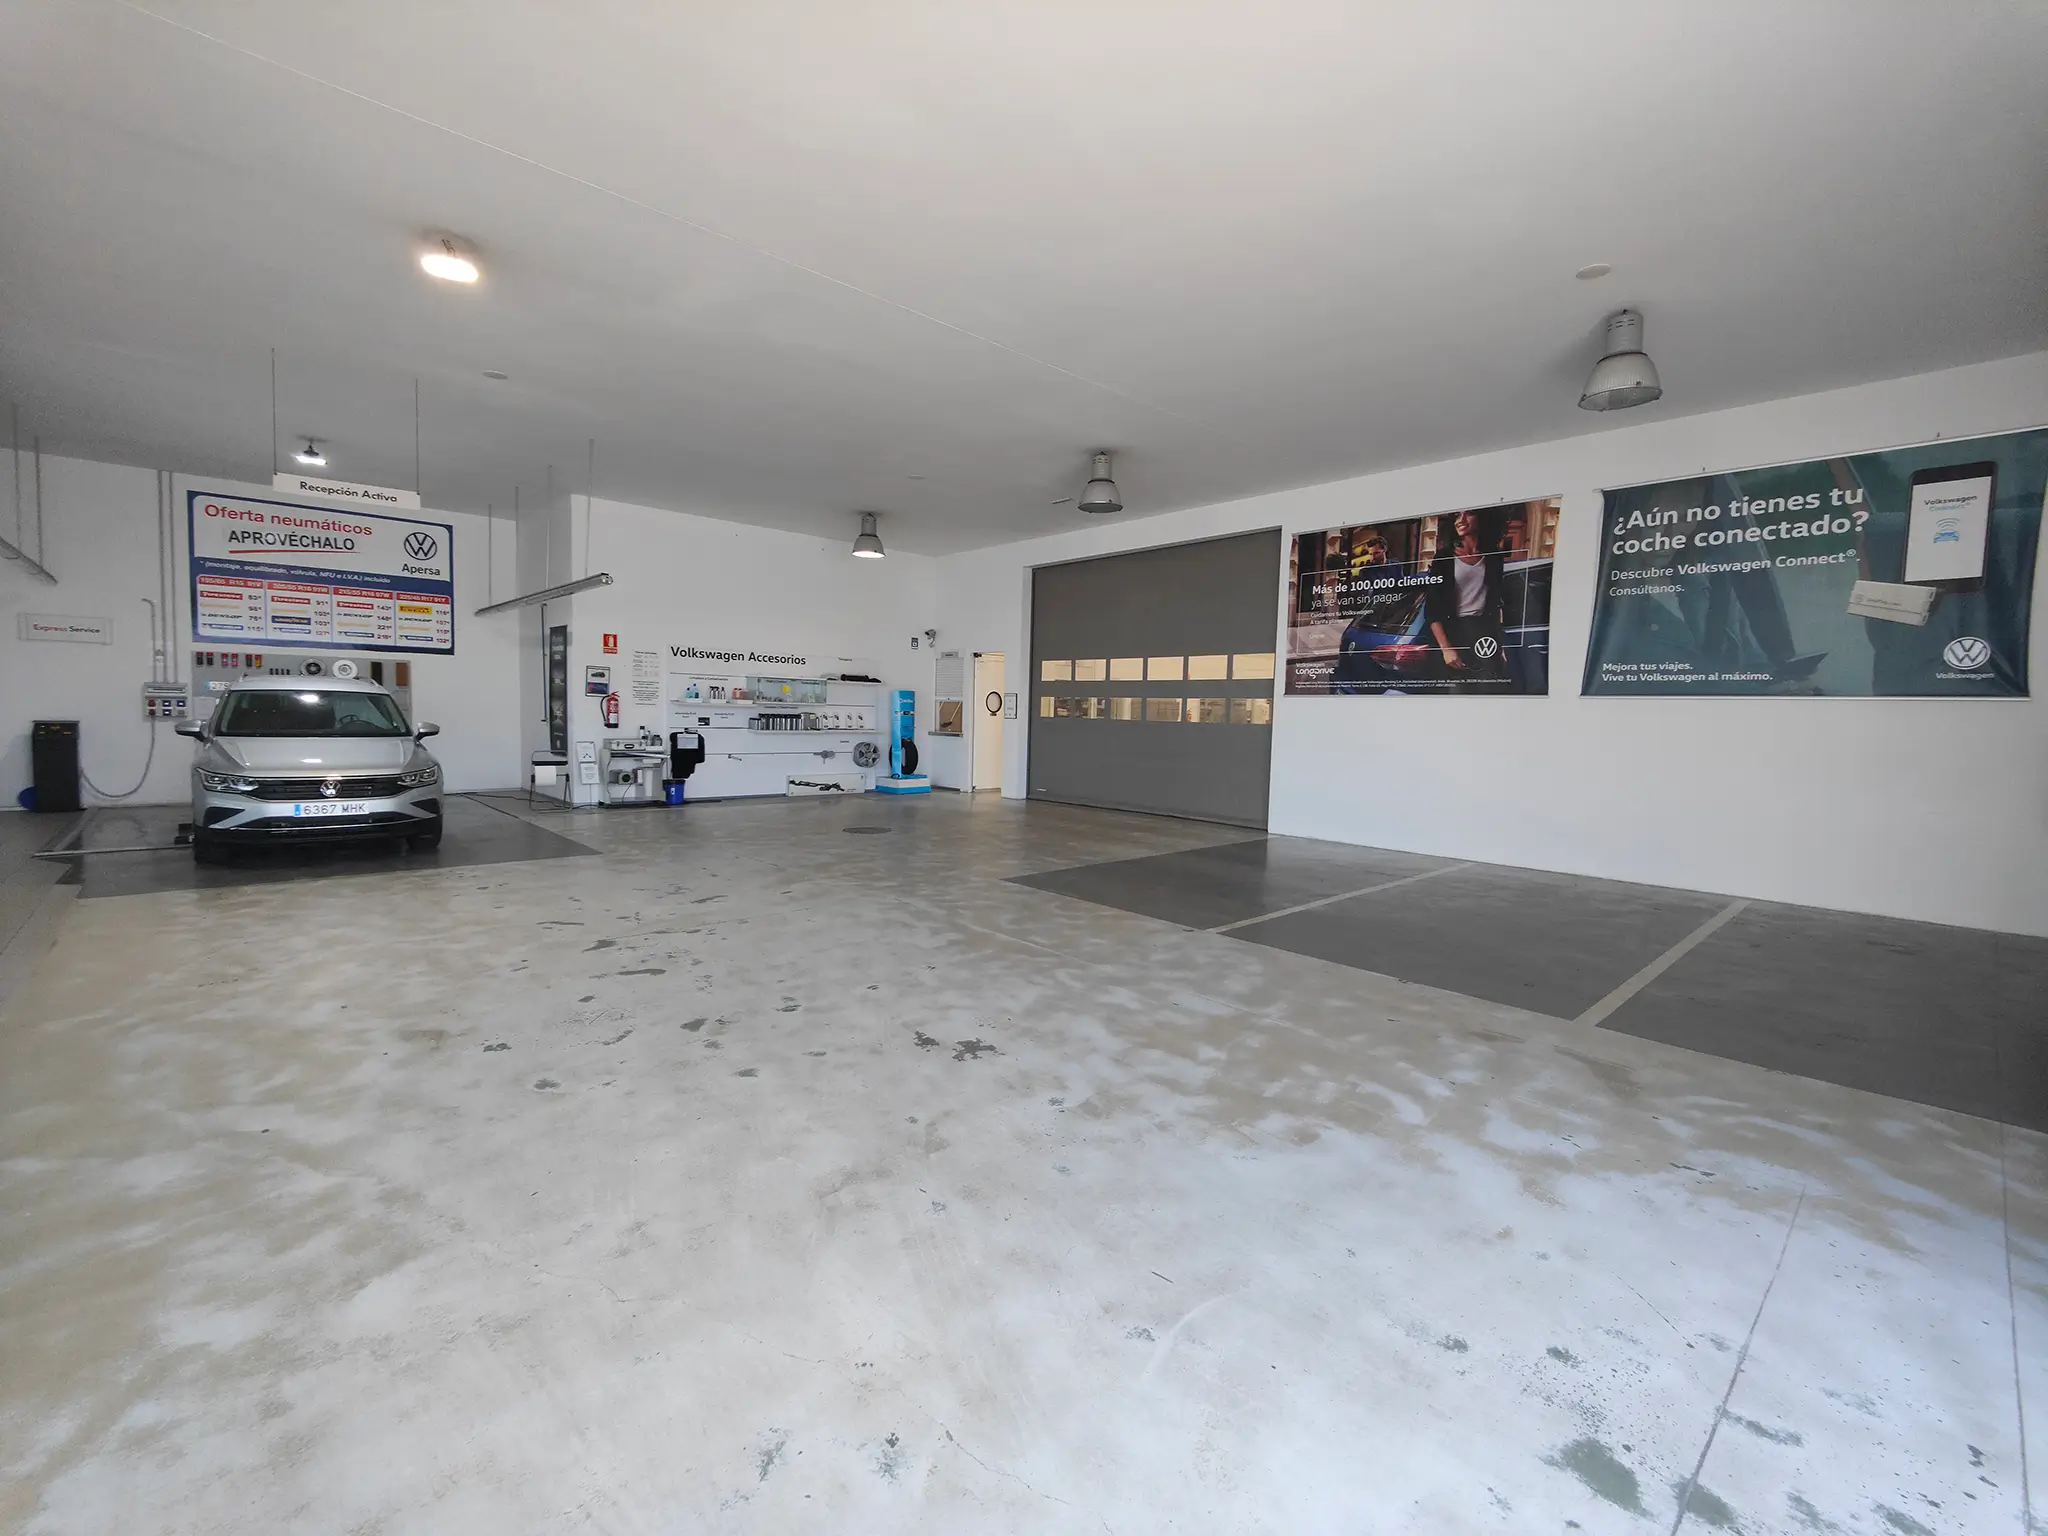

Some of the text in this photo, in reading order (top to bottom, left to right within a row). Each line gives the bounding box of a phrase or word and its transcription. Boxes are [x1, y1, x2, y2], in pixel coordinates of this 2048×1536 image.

[300, 481, 359, 497] Recepción
[1924, 495, 1978, 506] Volkswagen
[1613, 488, 1864, 535] ¿Aún no tienes tu
[204, 504, 373, 536] Oferta neumáticos
[228, 530, 355, 551] APROVÉCHALO
[1612, 511, 1870, 555] coche conectado?
[401, 563, 441, 576] Apersa
[1611, 567, 1674, 581] Descubre
[1677, 559, 1772, 575] Volkswagen
[1312, 575, 1444, 595] Más de 100.000 clientes
[1609, 583, 1685, 597] Consúltanos.
[1311, 592, 1403, 610] ya se van sin pagar
[1342, 608, 1374, 617] Volkswagen
[33, 623, 101, 633] Express Service
[671, 646, 807, 666] Volkswagen Accesorios
[1602, 661, 1694, 673] Mejora tus viajes.
[1602, 671, 1774, 683] Vive tu Volkswagen al máximo.
[1935, 671, 1996, 680] Volkswagen
[303, 804, 338, 815] 6367
